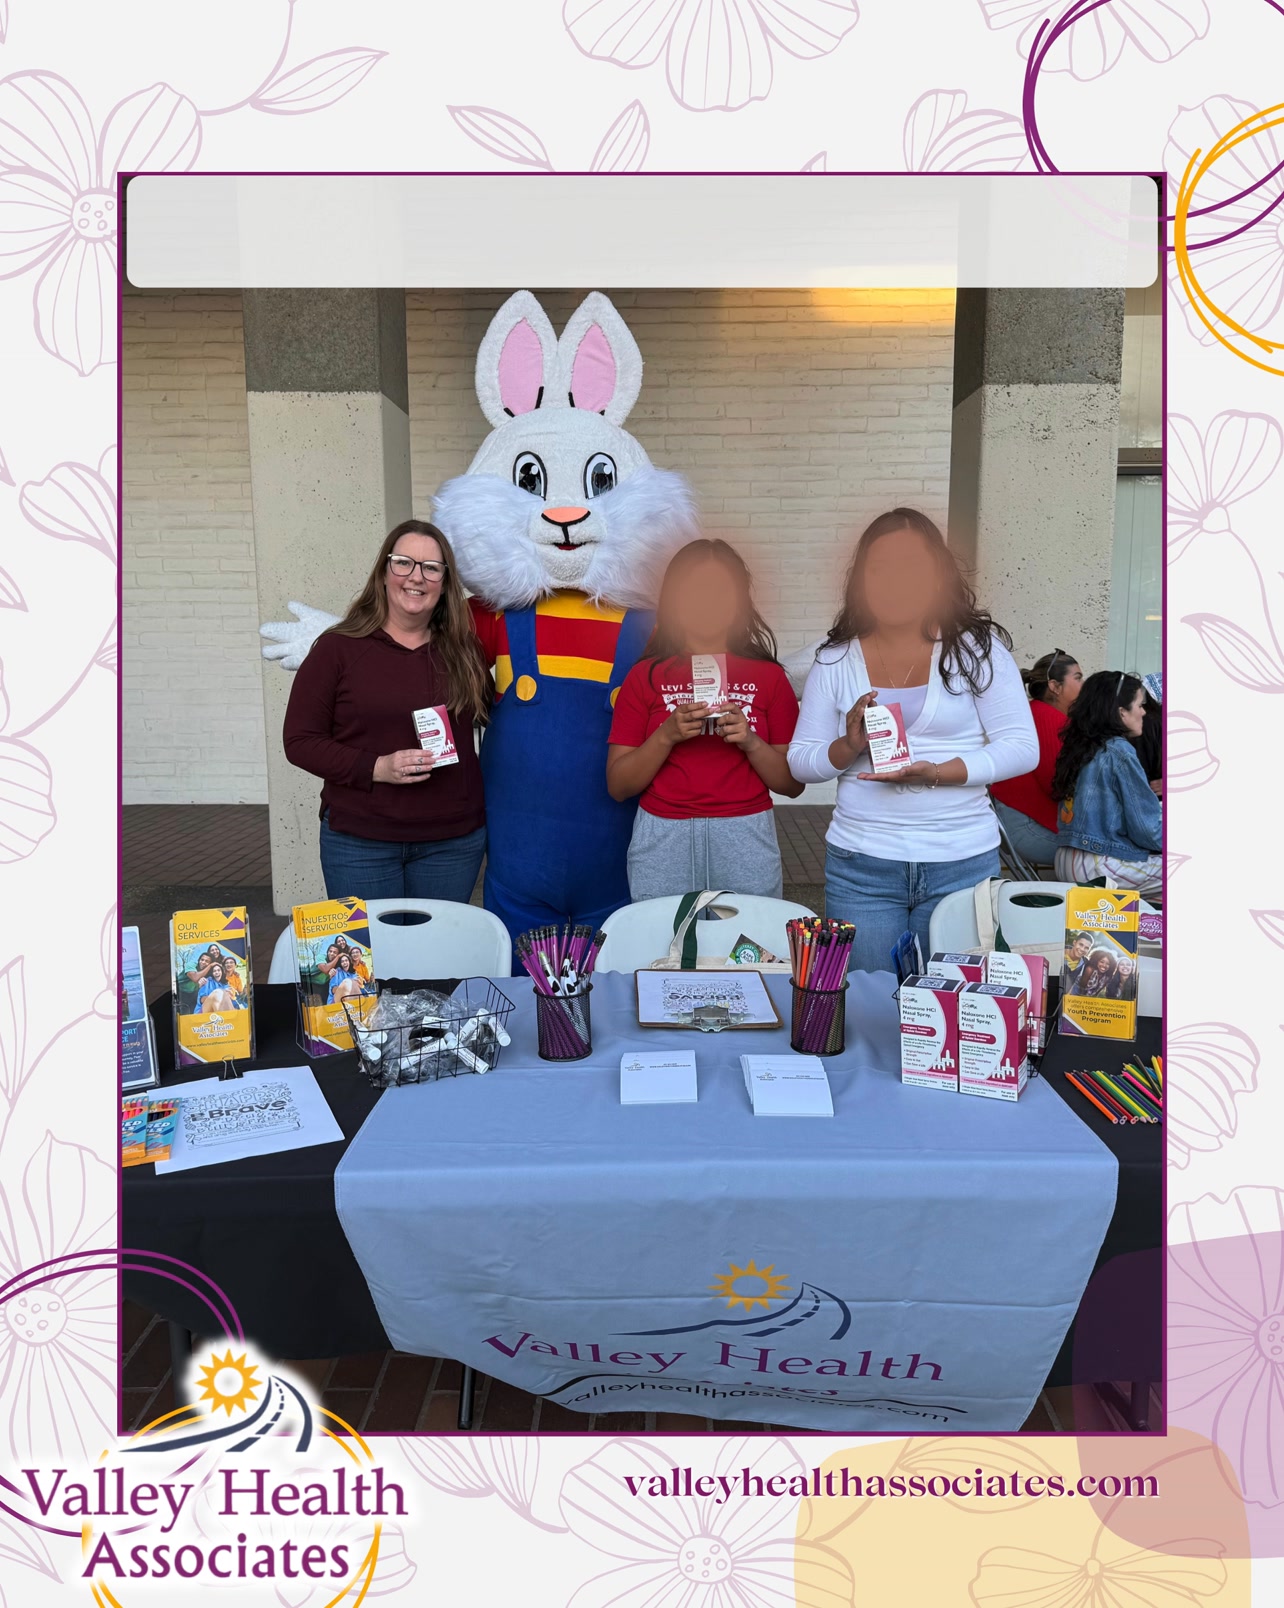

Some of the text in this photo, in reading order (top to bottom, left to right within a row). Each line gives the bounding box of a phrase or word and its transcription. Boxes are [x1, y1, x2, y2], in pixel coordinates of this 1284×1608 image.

[305, 912, 348, 924] NUESTROS
[1075, 911, 1126, 922] Valley Health
[306, 922, 348, 934] SERVICIOS
[178, 930, 220, 940] SERVICES
[1082, 1016, 1111, 1024] Program
[1089, 1011, 1126, 1019] Prevention
[203, 1088, 285, 1109] HAPPY
[209, 1100, 287, 1118] Brave
[481, 1331, 944, 1381] Valley Health
